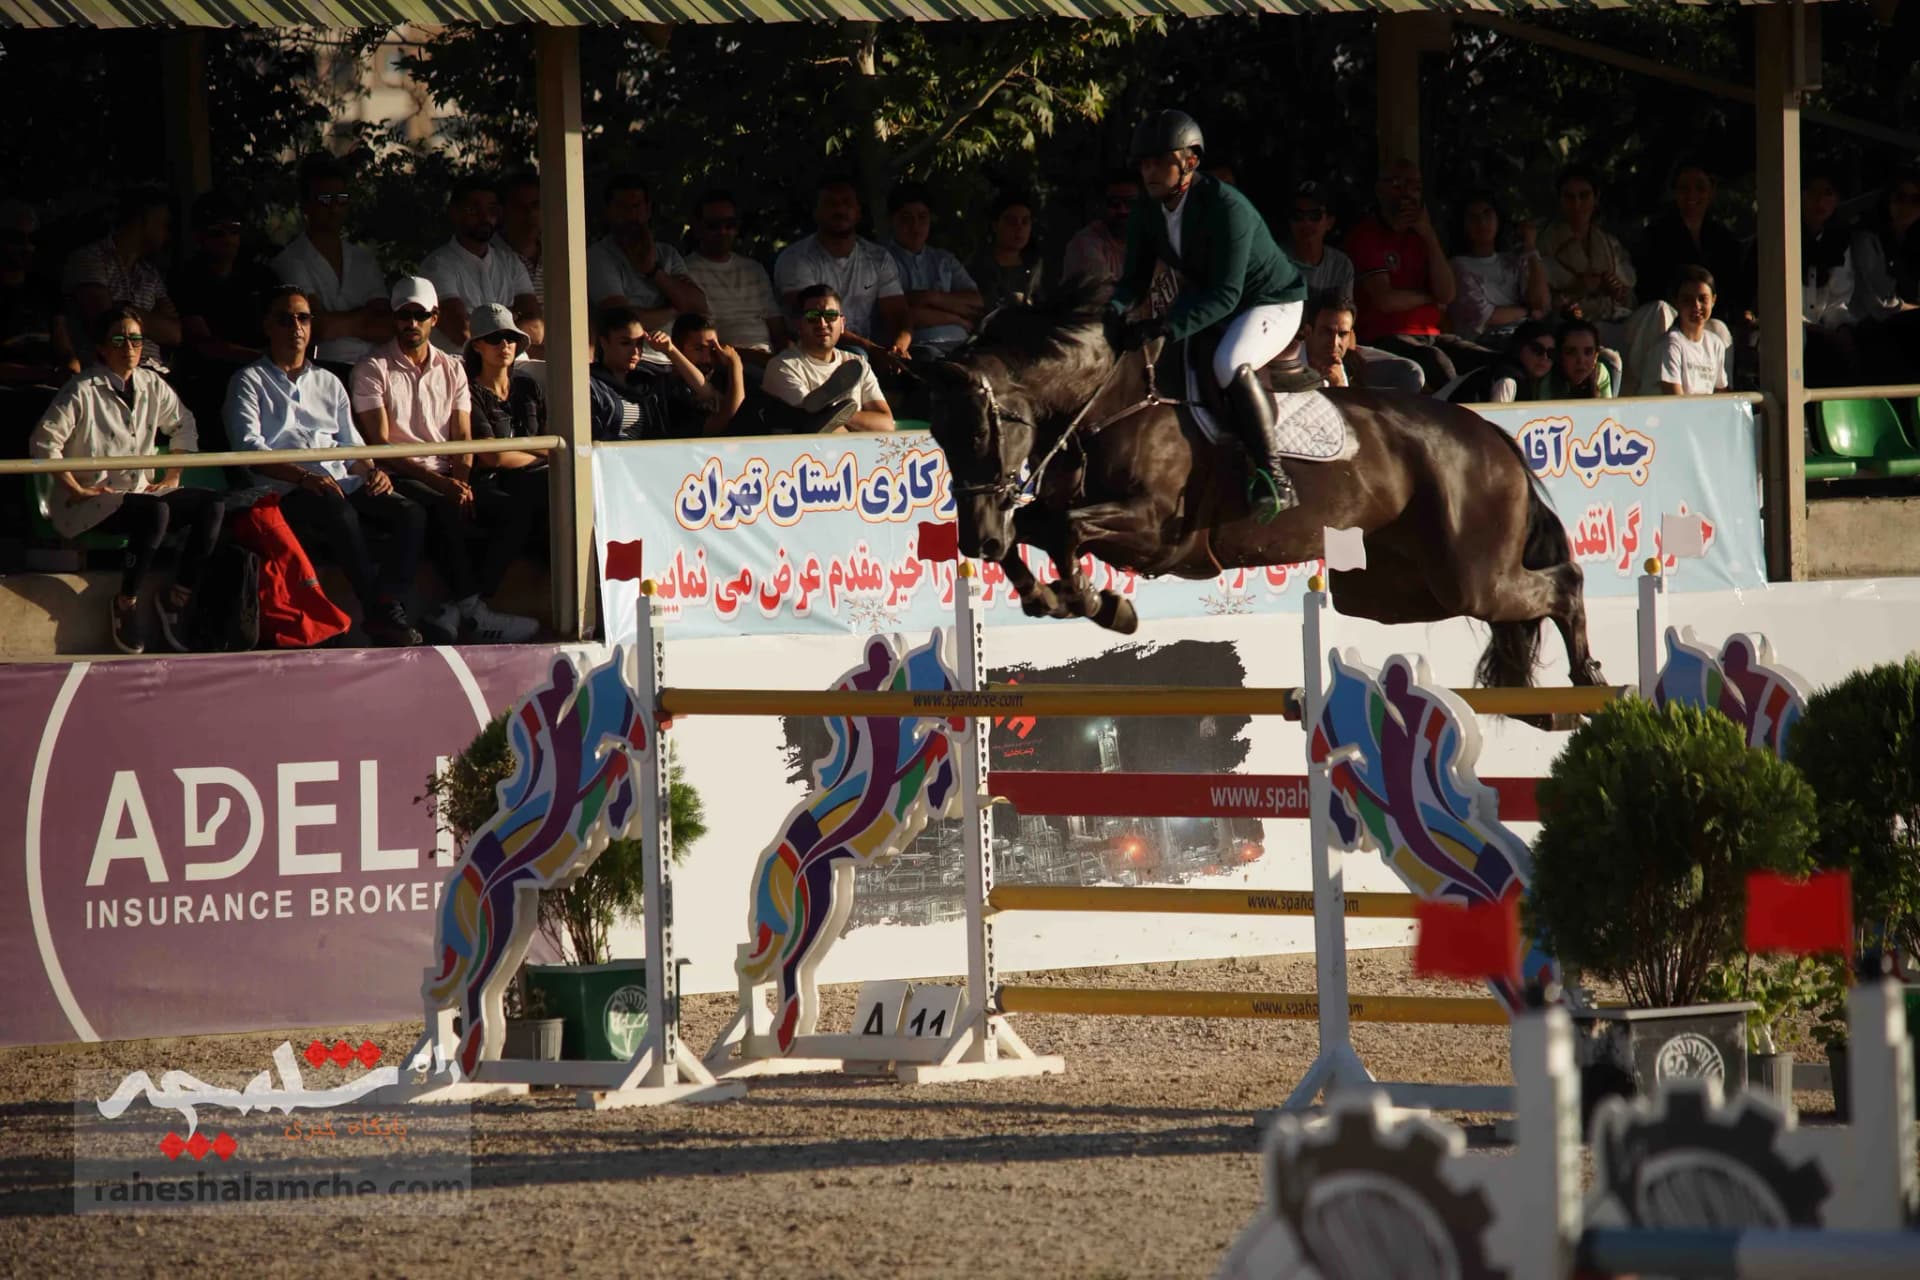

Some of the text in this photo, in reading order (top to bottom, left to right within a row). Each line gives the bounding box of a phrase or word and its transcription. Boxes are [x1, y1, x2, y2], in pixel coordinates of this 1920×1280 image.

[1575, 427, 1648, 480] جناب
[681, 466, 762, 521] تهران
[773, 461, 852, 518] استان
[715, 568, 752, 613] می
[760, 548, 820, 610] عرض
[829, 545, 882, 608] مقدم
[887, 541, 923, 606] خیر
[1210, 779, 1309, 814] www.spah
[86, 890, 293, 929] INSURANCE
[910, 1007, 946, 1036] 11
